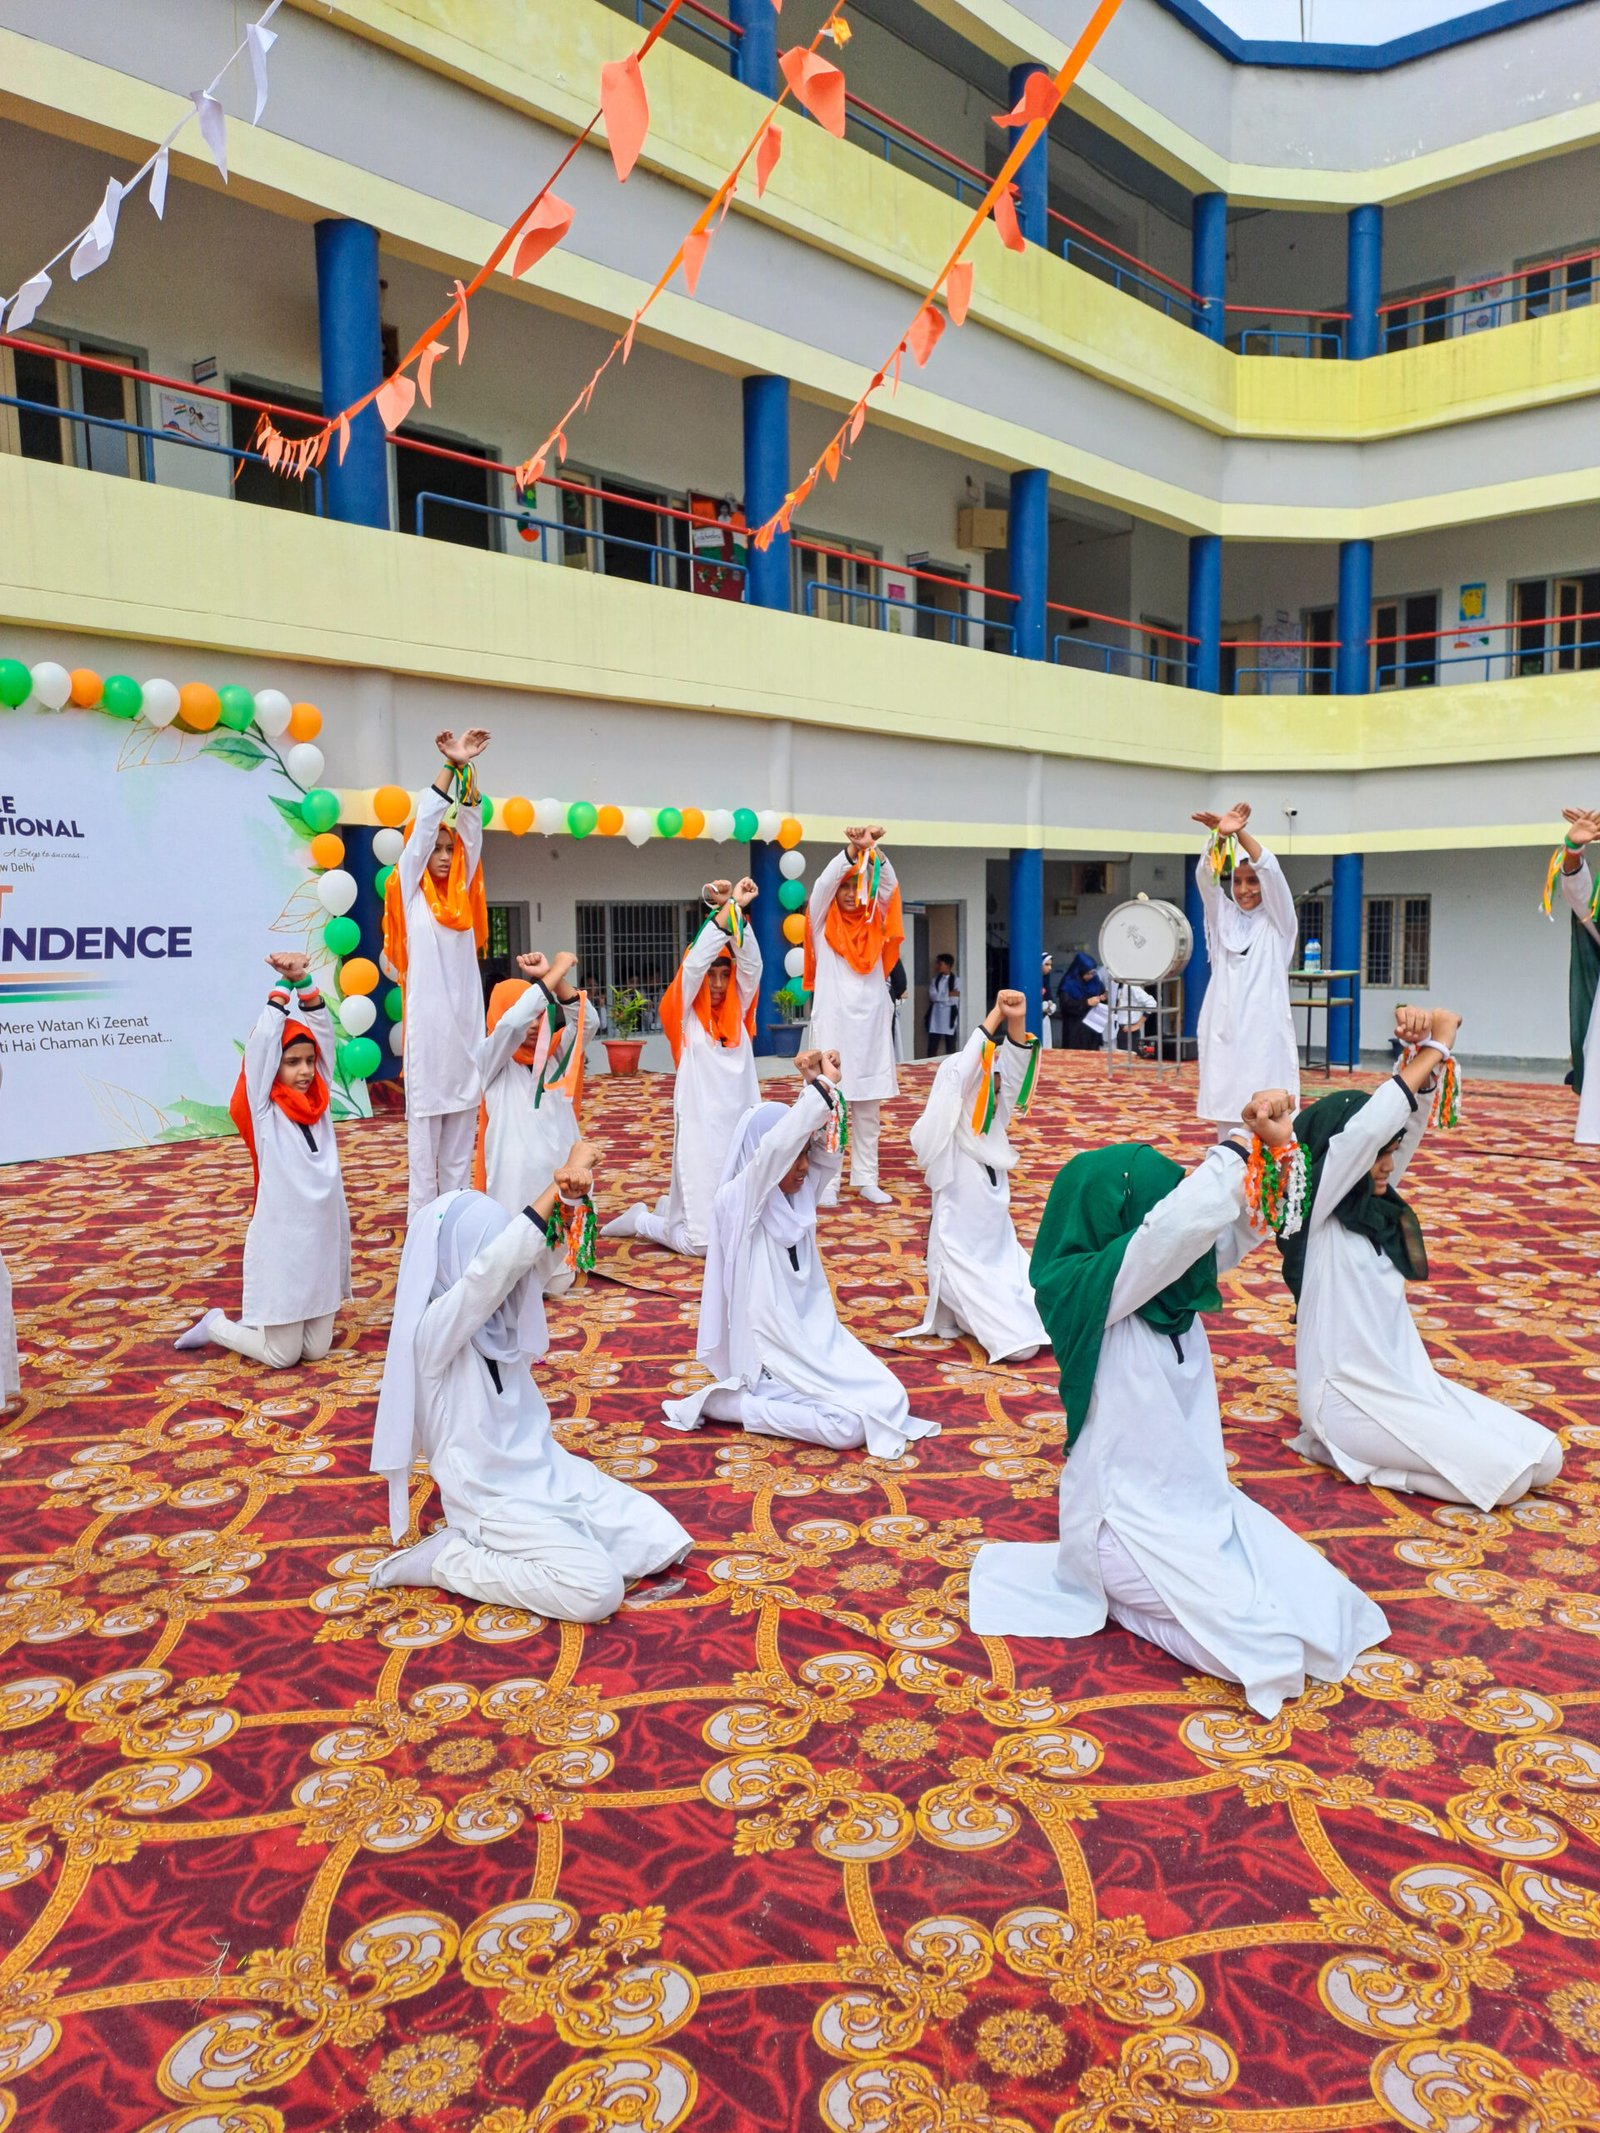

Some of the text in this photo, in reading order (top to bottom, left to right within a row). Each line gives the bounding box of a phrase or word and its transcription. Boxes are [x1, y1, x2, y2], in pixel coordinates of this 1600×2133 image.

[0, 795, 16, 814] E
[42, 850, 50, 858] to
[10, 862, 35, 873] Delhi
[0, 1015, 149, 1034] Mere Watan Ki Zeenat
[12, 1038, 36, 1052] Hai
[40, 1034, 99, 1050] Chaman
[101, 1033, 115, 1047] Ki
[117, 1032, 173, 1046] Zeenat...
